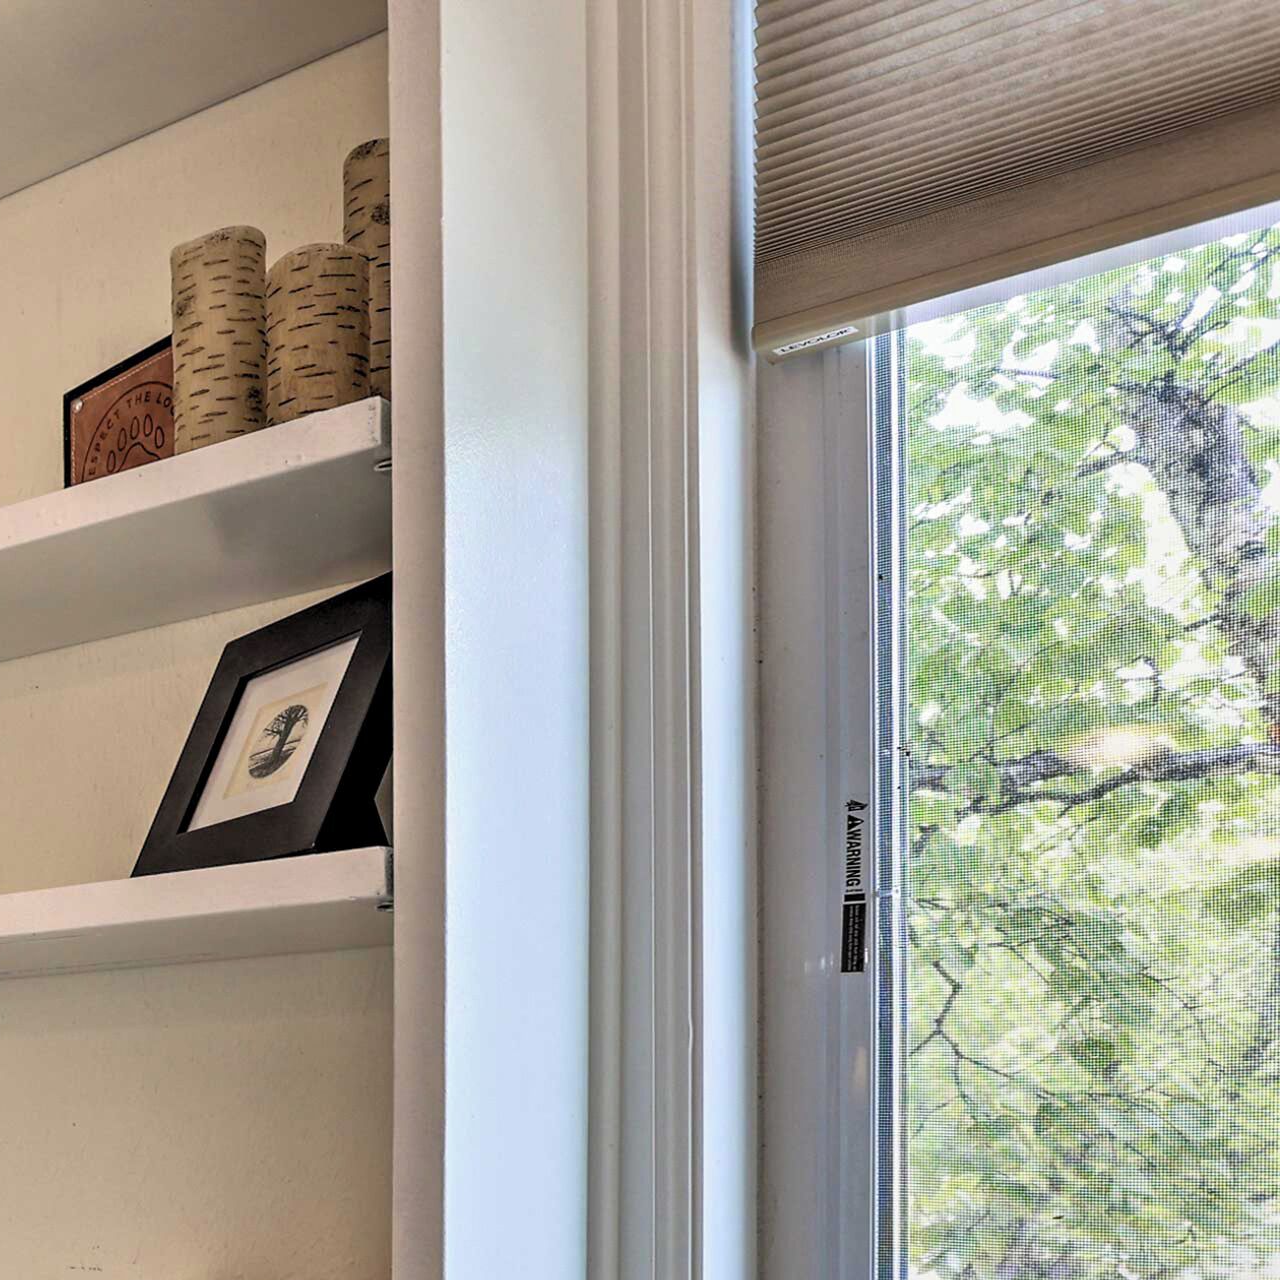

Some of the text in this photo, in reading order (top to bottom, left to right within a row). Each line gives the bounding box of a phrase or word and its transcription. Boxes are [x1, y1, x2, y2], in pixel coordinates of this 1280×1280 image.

[779, 329, 849, 352] LEVOLOR
[87, 391, 151, 476] ESPECT THE
